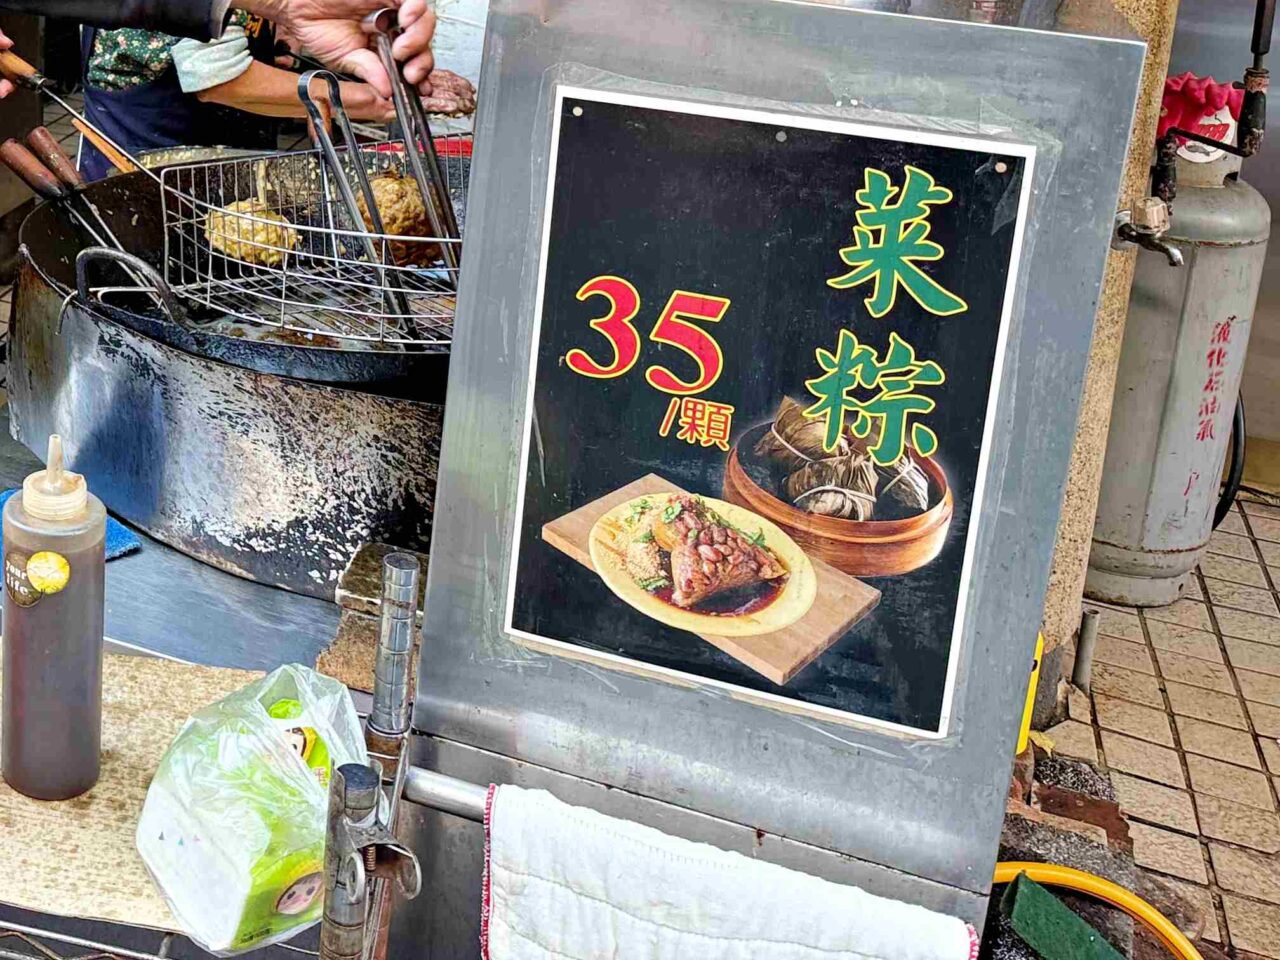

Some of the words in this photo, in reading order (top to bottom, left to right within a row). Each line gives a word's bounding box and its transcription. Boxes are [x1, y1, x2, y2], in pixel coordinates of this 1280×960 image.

[565, 274, 732, 395] 35
[803, 164, 969, 467] 菜粽
[658, 396, 736, 453] /顆
